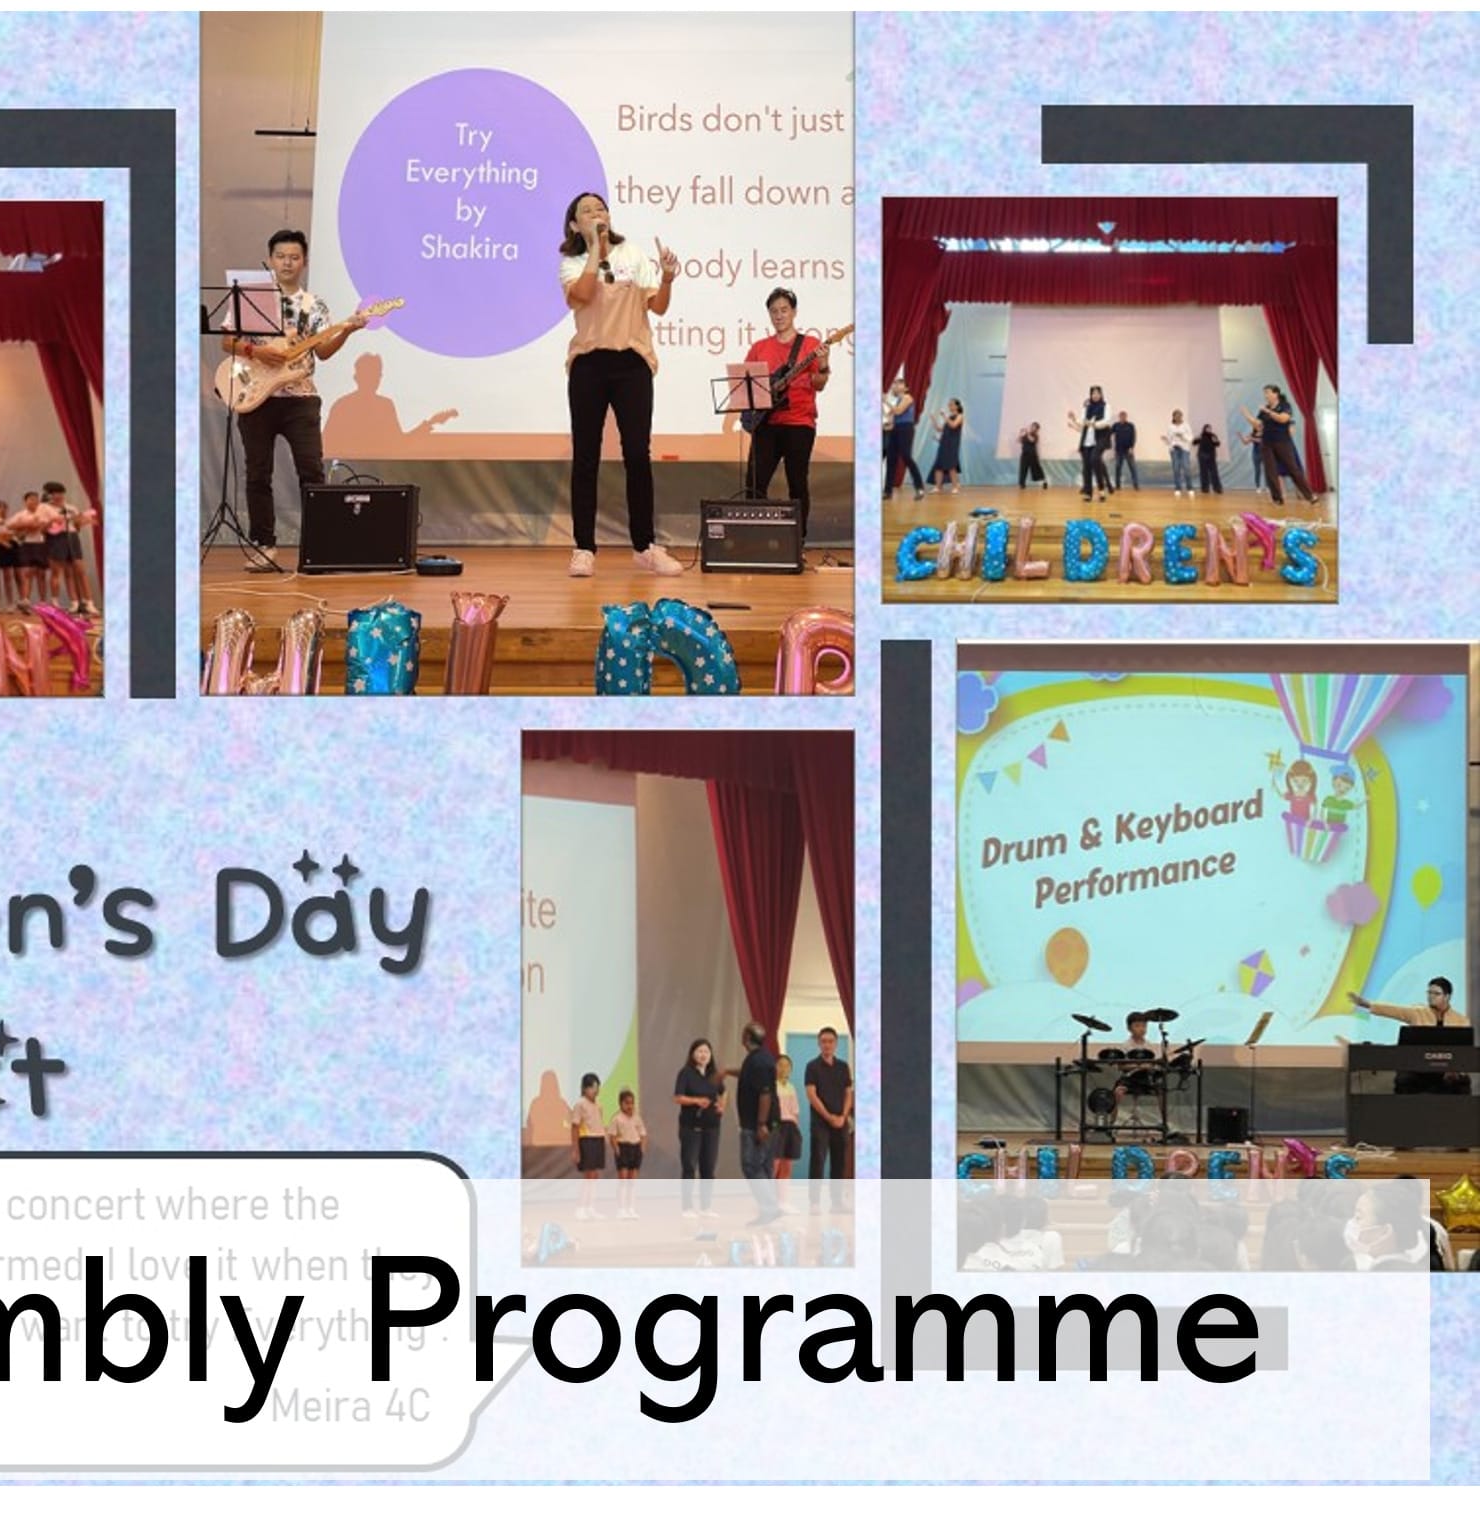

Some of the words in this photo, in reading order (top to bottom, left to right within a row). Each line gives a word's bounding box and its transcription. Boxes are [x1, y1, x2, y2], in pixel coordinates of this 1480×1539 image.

[456, 122, 493, 152] Try
[618, 103, 693, 132] Birds
[702, 103, 783, 132] don't
[789, 106, 845, 140] just
[406, 159, 538, 190] Everything
[616, 175, 682, 213] they
[690, 175, 734, 206] fall
[744, 176, 830, 206] down
[456, 197, 486, 227] by
[421, 233, 518, 261] Shakira
[753, 250, 845, 280] learns
[652, 318, 725, 354] tting
[738, 318, 758, 346] it
[982, 832, 1067, 869] Drum
[1080, 817, 1103, 850] &
[1115, 788, 1264, 844] Keyboard
[1035, 851, 1236, 909] Performance
